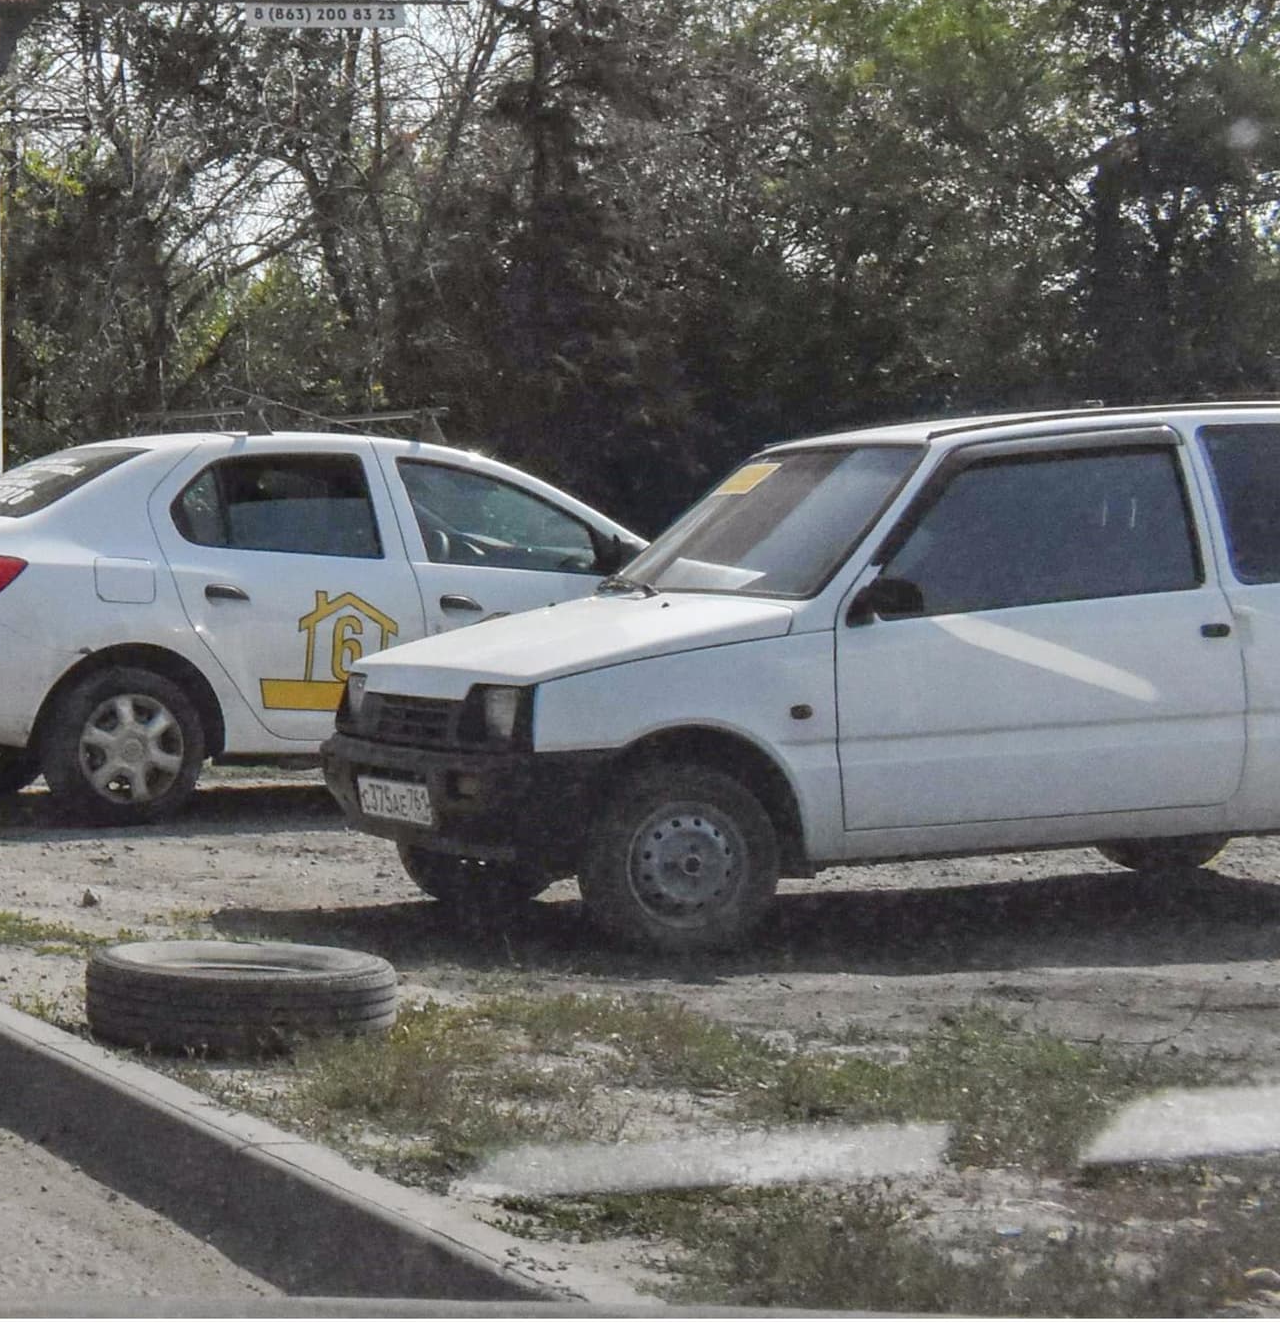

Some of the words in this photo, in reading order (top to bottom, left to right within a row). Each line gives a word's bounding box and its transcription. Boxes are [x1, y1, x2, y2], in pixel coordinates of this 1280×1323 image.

[254, 7, 264, 20] 8
[268, 6, 312, 23] (863)
[316, 8, 347, 21] 200
[352, 8, 373, 21] 83
[377, 8, 396, 21] 23
